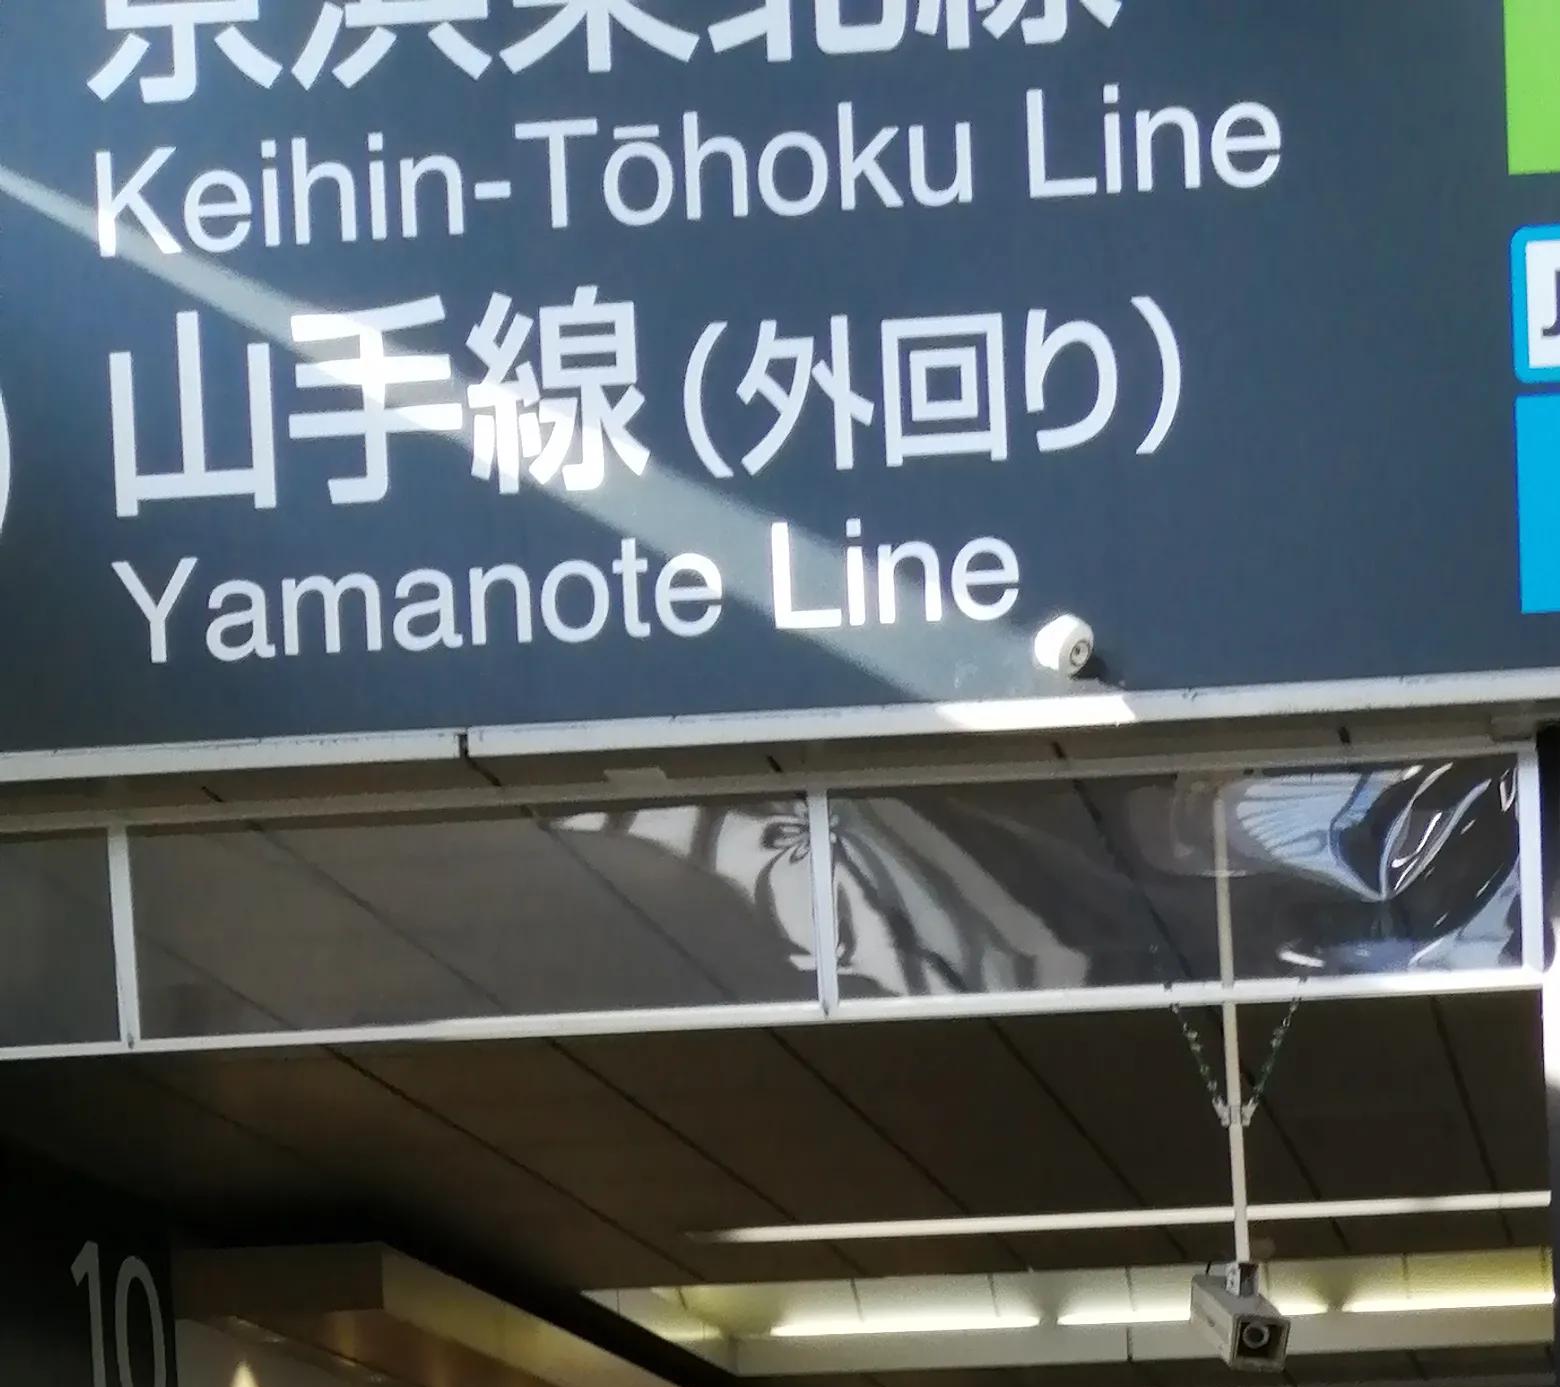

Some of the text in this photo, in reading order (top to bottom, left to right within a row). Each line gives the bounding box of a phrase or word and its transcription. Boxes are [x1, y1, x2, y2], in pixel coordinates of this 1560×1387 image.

[94, 85, 1282, 258] Keihin-Tōhoku Line
[112, 521, 1021, 665] Yamanote Line
